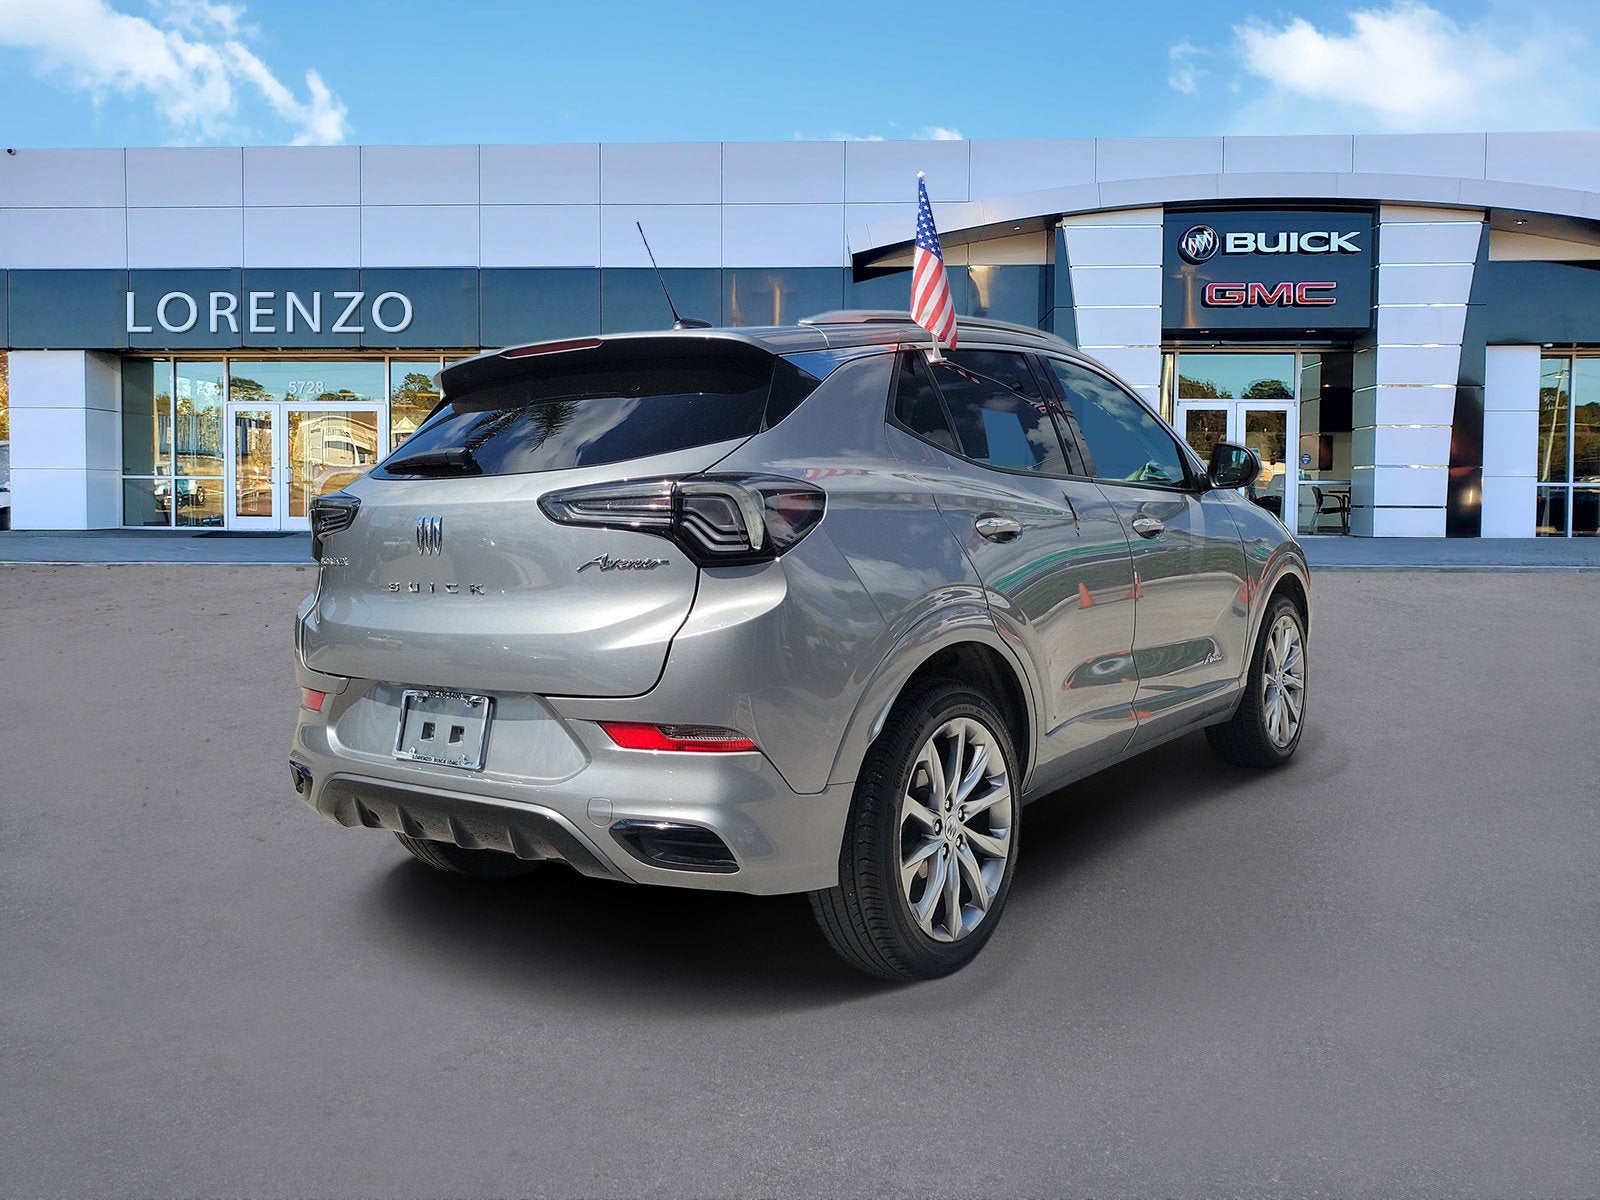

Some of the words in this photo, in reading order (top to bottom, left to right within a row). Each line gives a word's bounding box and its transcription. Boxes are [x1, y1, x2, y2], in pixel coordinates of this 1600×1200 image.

[1225, 231, 1362, 253] BUICK
[1205, 281, 1337, 305] GMC
[126, 291, 414, 333] LORENZO
[288, 380, 325, 394] 5728
[388, 581, 485, 596] BUICK
